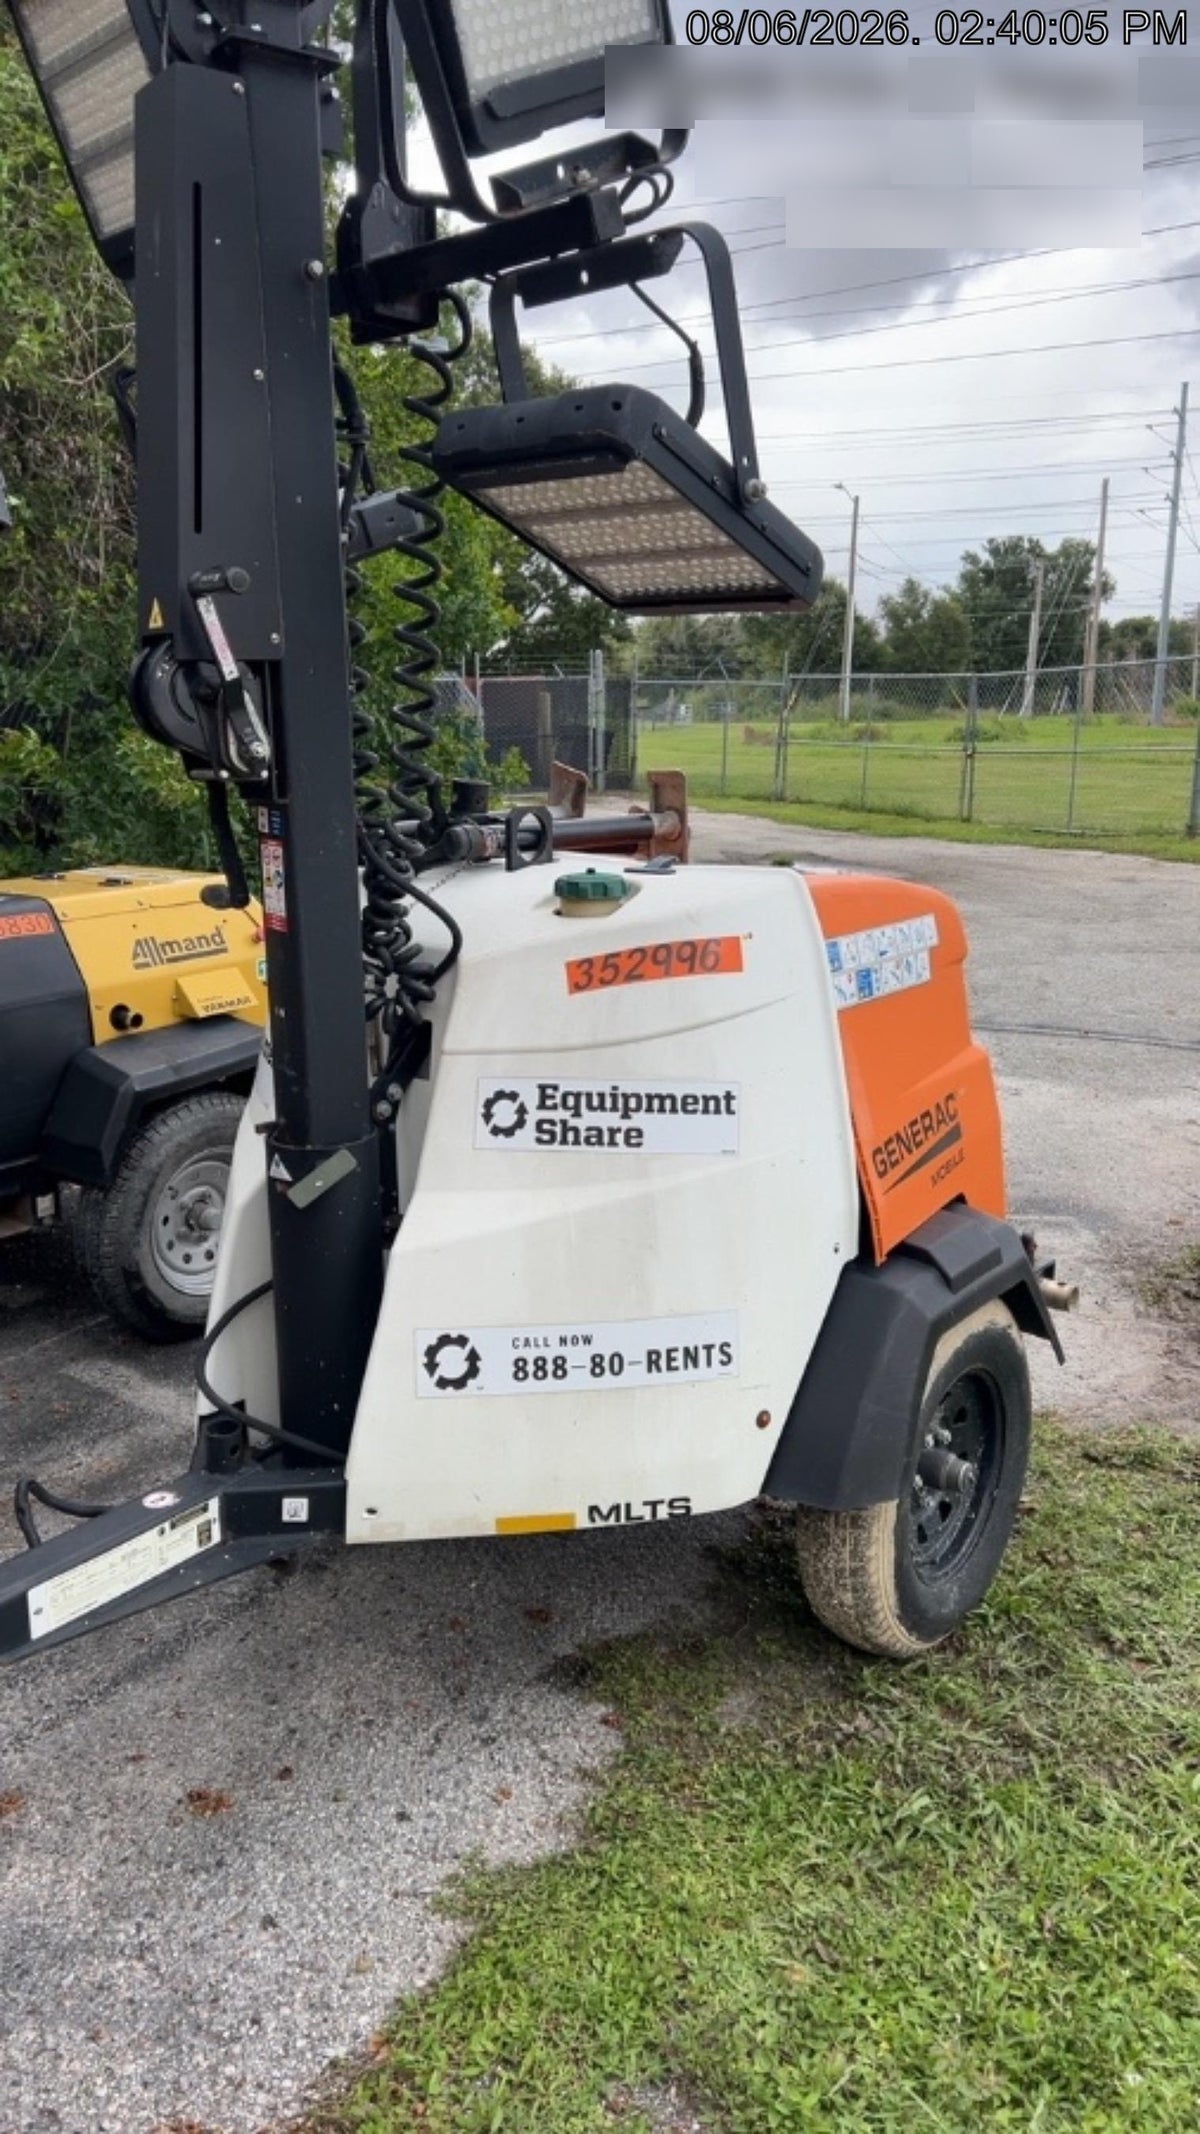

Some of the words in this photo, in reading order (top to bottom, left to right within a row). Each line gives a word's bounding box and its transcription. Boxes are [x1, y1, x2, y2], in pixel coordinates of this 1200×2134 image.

[132, 928, 227, 967] Allmand
[573, 938, 722, 992] 352996
[535, 1083, 737, 1119] Equipment
[535, 1119, 644, 1149] Share
[872, 1091, 958, 1179] GENERAC
[930, 1147, 966, 1188] MOBILE
[511, 1335, 551, 1350] CALL
[558, 1334, 594, 1348] NOW
[511, 1341, 734, 1383] 888-80-RENTS
[587, 1496, 692, 1524] MLTS
